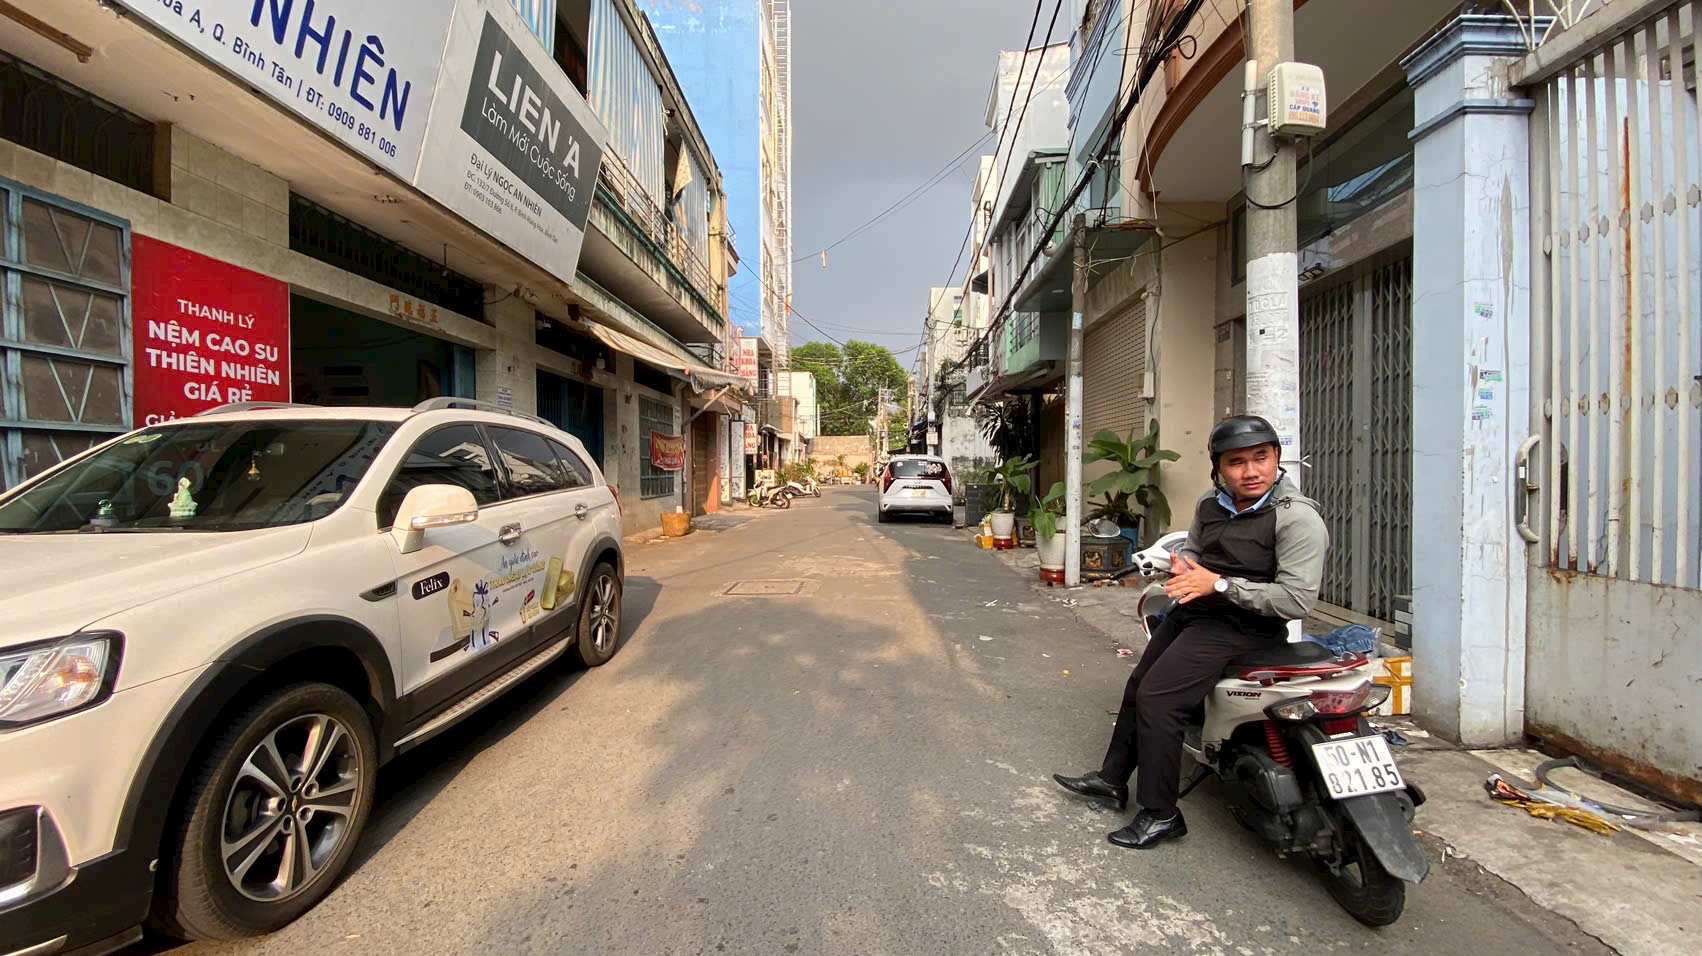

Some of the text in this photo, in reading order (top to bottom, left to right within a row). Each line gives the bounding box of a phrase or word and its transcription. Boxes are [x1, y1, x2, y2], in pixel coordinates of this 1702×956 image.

[189, 9, 204, 33] A,
[213, 23, 226, 45] Q.
[232, 37, 265, 71] Bình
[271, 61, 293, 89] Tân
[306, 88, 324, 110] ĐT:
[328, 102, 355, 130] 0909
[358, 123, 376, 144] 881
[379, 137, 396, 158] 006
[250, 0, 411, 131] NHIÊN
[488, 50, 560, 154] LIEN
[481, 97, 576, 202] Làm Mới Cuộc Sống
[493, 171, 513, 194] NGỌC
[177, 298, 255, 329] THANH LÝ
[148, 320, 278, 362] NỆM CAO SU
[146, 348, 280, 386] THIÊN NHIÊN
[184, 381, 252, 403] GIÁ RẺ
[420, 578, 443, 595] Felix
